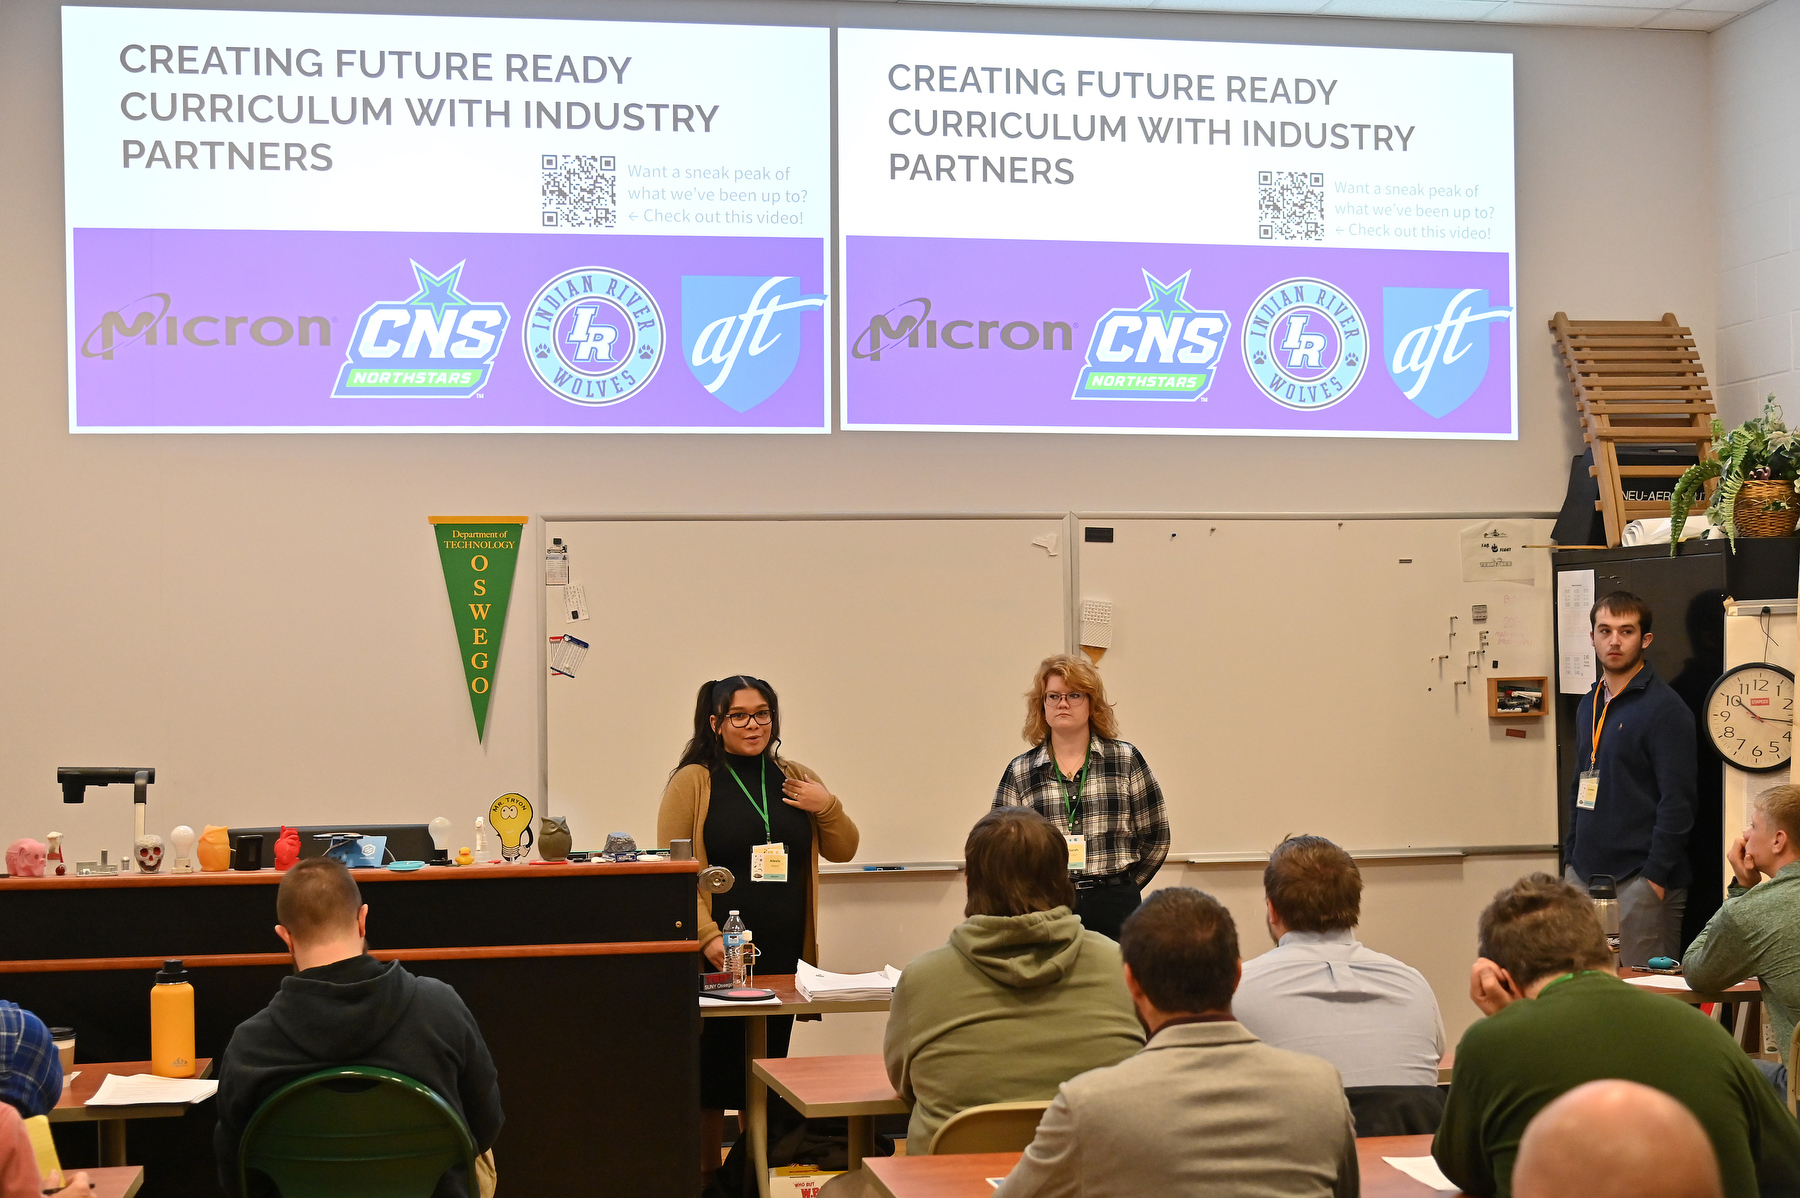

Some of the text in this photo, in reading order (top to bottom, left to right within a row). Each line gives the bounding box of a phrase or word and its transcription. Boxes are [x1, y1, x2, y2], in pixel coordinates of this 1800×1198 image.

[120, 44, 632, 84] CREATING FUTURE READY
[888, 63, 1338, 105] CREATING FUTURE READY
[121, 91, 720, 133] CURRICULUM WITH INDUSTRY
[888, 108, 1416, 152] CURRICULUM WITH INDUSTRY
[122, 139, 333, 172] PARTNERS
[628, 164, 791, 183] Want a sneak peak of
[890, 153, 1075, 185] PARTNERS
[628, 186, 666, 200] what
[719, 188, 757, 202] been
[761, 191, 781, 205] up
[785, 189, 808, 203] to?
[1334, 181, 1479, 199] Want a sneak peak of
[643, 208, 804, 225] Check out this video!
[1335, 202, 1369, 215] what
[1416, 204, 1449, 218] been
[1453, 208, 1470, 221] up
[1475, 206, 1495, 219] to?
[1348, 223, 1491, 240] Check out this video!
[532, 275, 655, 331] INDIAN RIVER
[1250, 286, 1360, 339] INDIAN RIVER
[358, 309, 502, 358] CNS
[565, 305, 619, 362] IR
[691, 276, 825, 393] aft
[1096, 315, 1224, 364] CNS
[1280, 314, 1327, 369] IR
[1392, 288, 1511, 400] aft
[353, 372, 472, 384] NORTHSTARS
[553, 367, 636, 398] WOLVES
[1092, 375, 1197, 388] NORTHSTARS
[1269, 373, 1343, 402] WOLVES
[444, 540, 515, 549] TECHNOLOGY
[452, 530, 508, 540] Department of
[468, 554, 491, 694] OSWEGO
[1739, 683, 1750, 695] 11
[1753, 679, 1769, 691] 12
[1776, 685, 1781, 696] 1
[1726, 695, 1742, 706] 10
[1783, 698, 1793, 710] 2
[1720, 711, 1731, 722] 9
[1723, 726, 1734, 738] 8
[1782, 731, 1792, 742] 4
[1736, 738, 1746, 750] 7
[1752, 745, 1763, 757] 6
[1769, 741, 1780, 753] 5
[492, 797, 527, 812] MR. TRYON
